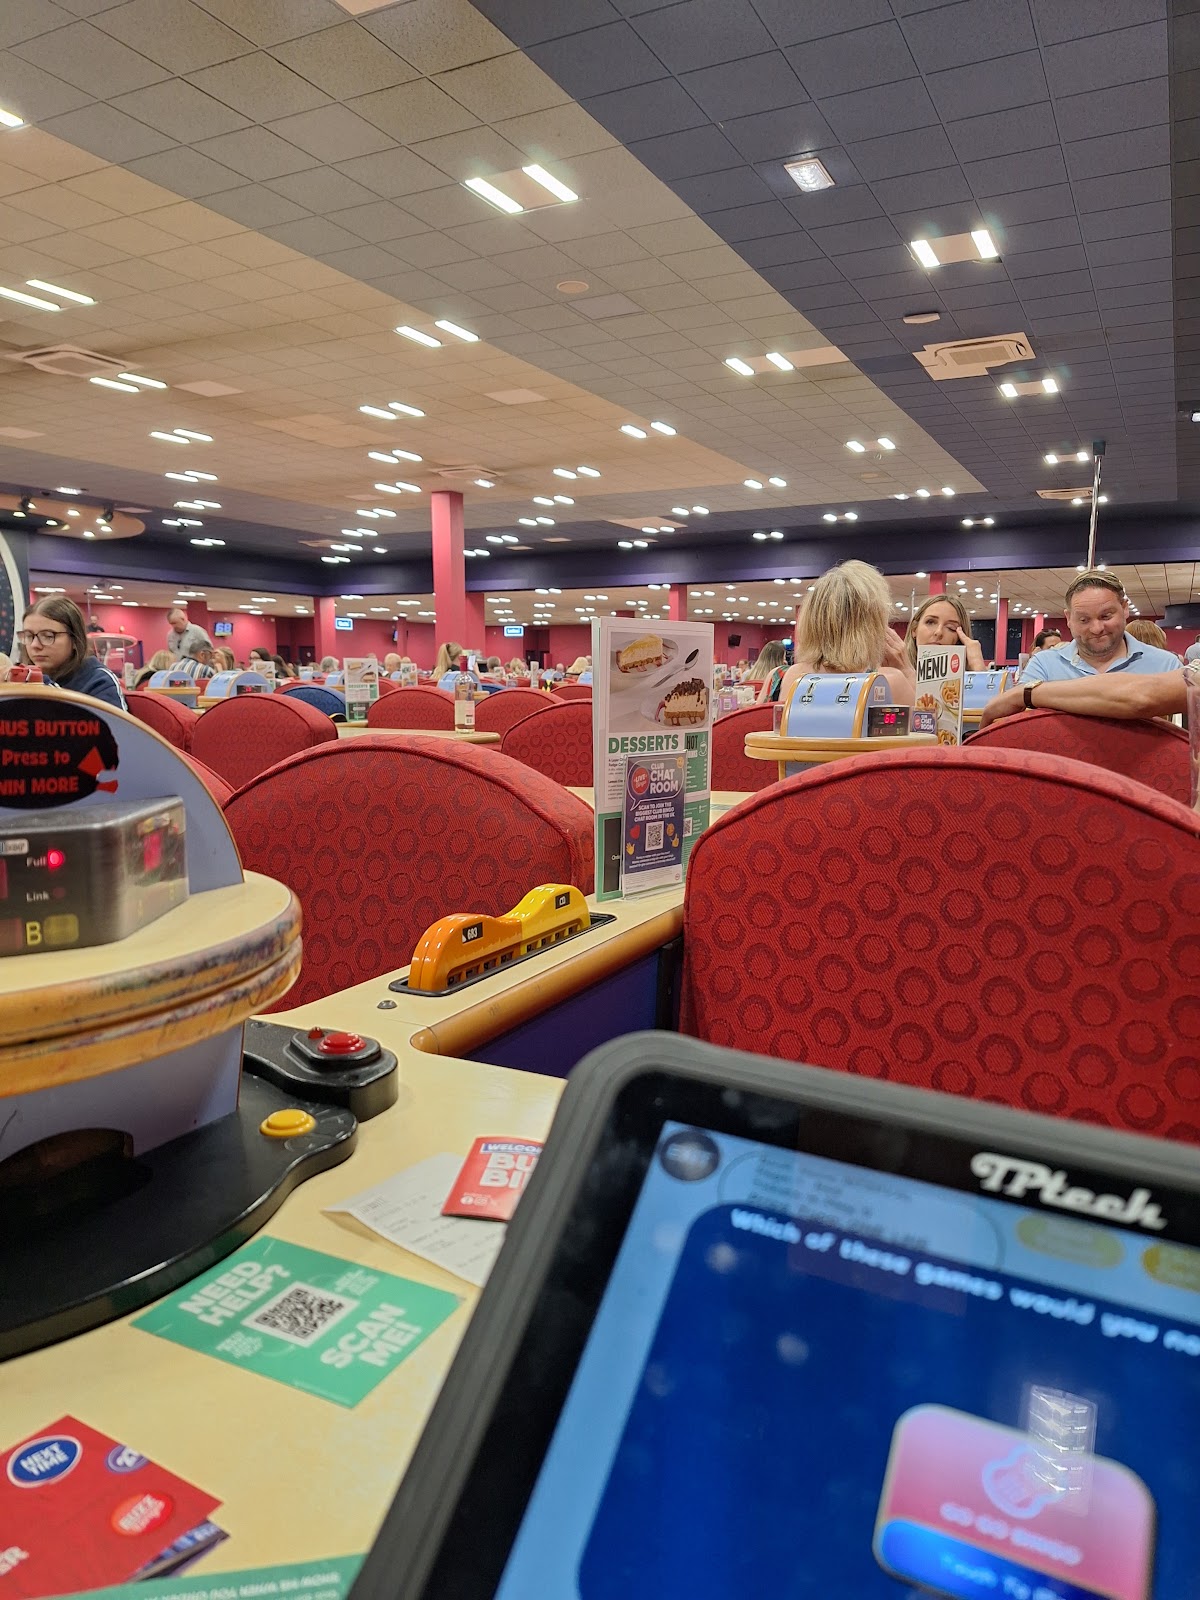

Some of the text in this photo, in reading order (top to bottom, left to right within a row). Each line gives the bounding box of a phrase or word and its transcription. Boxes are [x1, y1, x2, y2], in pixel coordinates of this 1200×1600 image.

[216, 622, 232, 632] 68
[917, 655, 948, 681] MENU
[35, 720, 99, 737] BUTTON
[608, 734, 679, 754] DESSERTS
[686, 735, 698, 750] HOT
[2, 749, 70, 766] Press to
[31, 776, 79, 794] MORE
[650, 769, 675, 782] CHAT
[650, 780, 678, 795] ROOM
[26, 856, 47, 868] Full
[26, 891, 49, 902] Link
[26, 920, 42, 946] B
[467, 927, 478, 941] 683
[731, 1208, 801, 1245] Which
[804, 1232, 836, 1252] of
[839, 1238, 912, 1276] these
[915, 1262, 1003, 1301] games
[1010, 1288, 1096, 1326] would
[1101, 1312, 1159, 1343] you
[178, 1260, 263, 1314] NEED
[198, 1263, 291, 1327] HELP?
[320, 1303, 406, 1369] SCAN
[359, 1323, 422, 1367] ME!
[20, 1441, 61, 1471] NEXT
[29, 1450, 70, 1477] TIME
